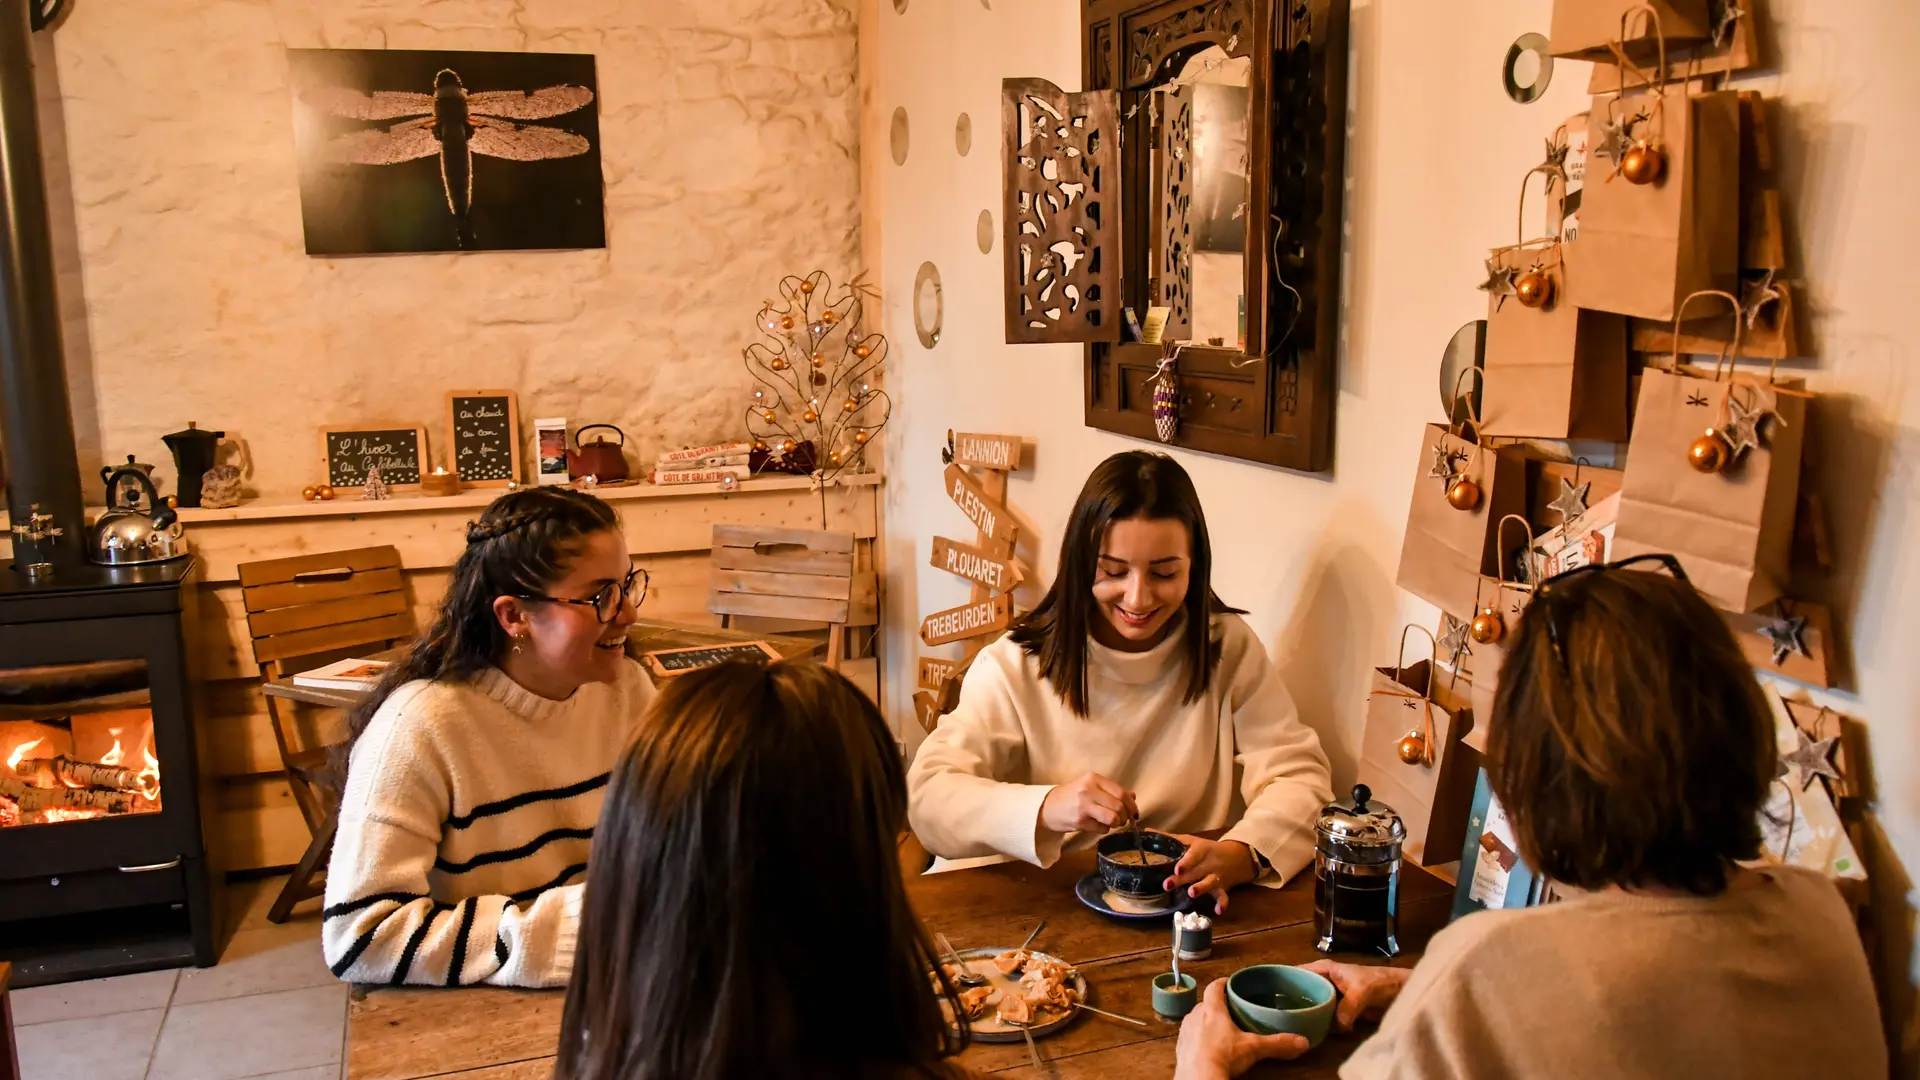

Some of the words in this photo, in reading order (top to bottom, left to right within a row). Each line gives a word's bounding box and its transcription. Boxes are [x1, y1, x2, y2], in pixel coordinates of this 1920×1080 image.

[476, 405, 504, 418] chaud
[336, 438, 399, 456] L'hiver
[962, 438, 1010, 466] LANNION
[663, 472, 680, 482] CÔTE
[681, 473, 689, 481] DE
[953, 478, 996, 539] PLESTIN
[946, 547, 1004, 587] PLOUARET
[926, 601, 996, 640] TREBEURDEN
